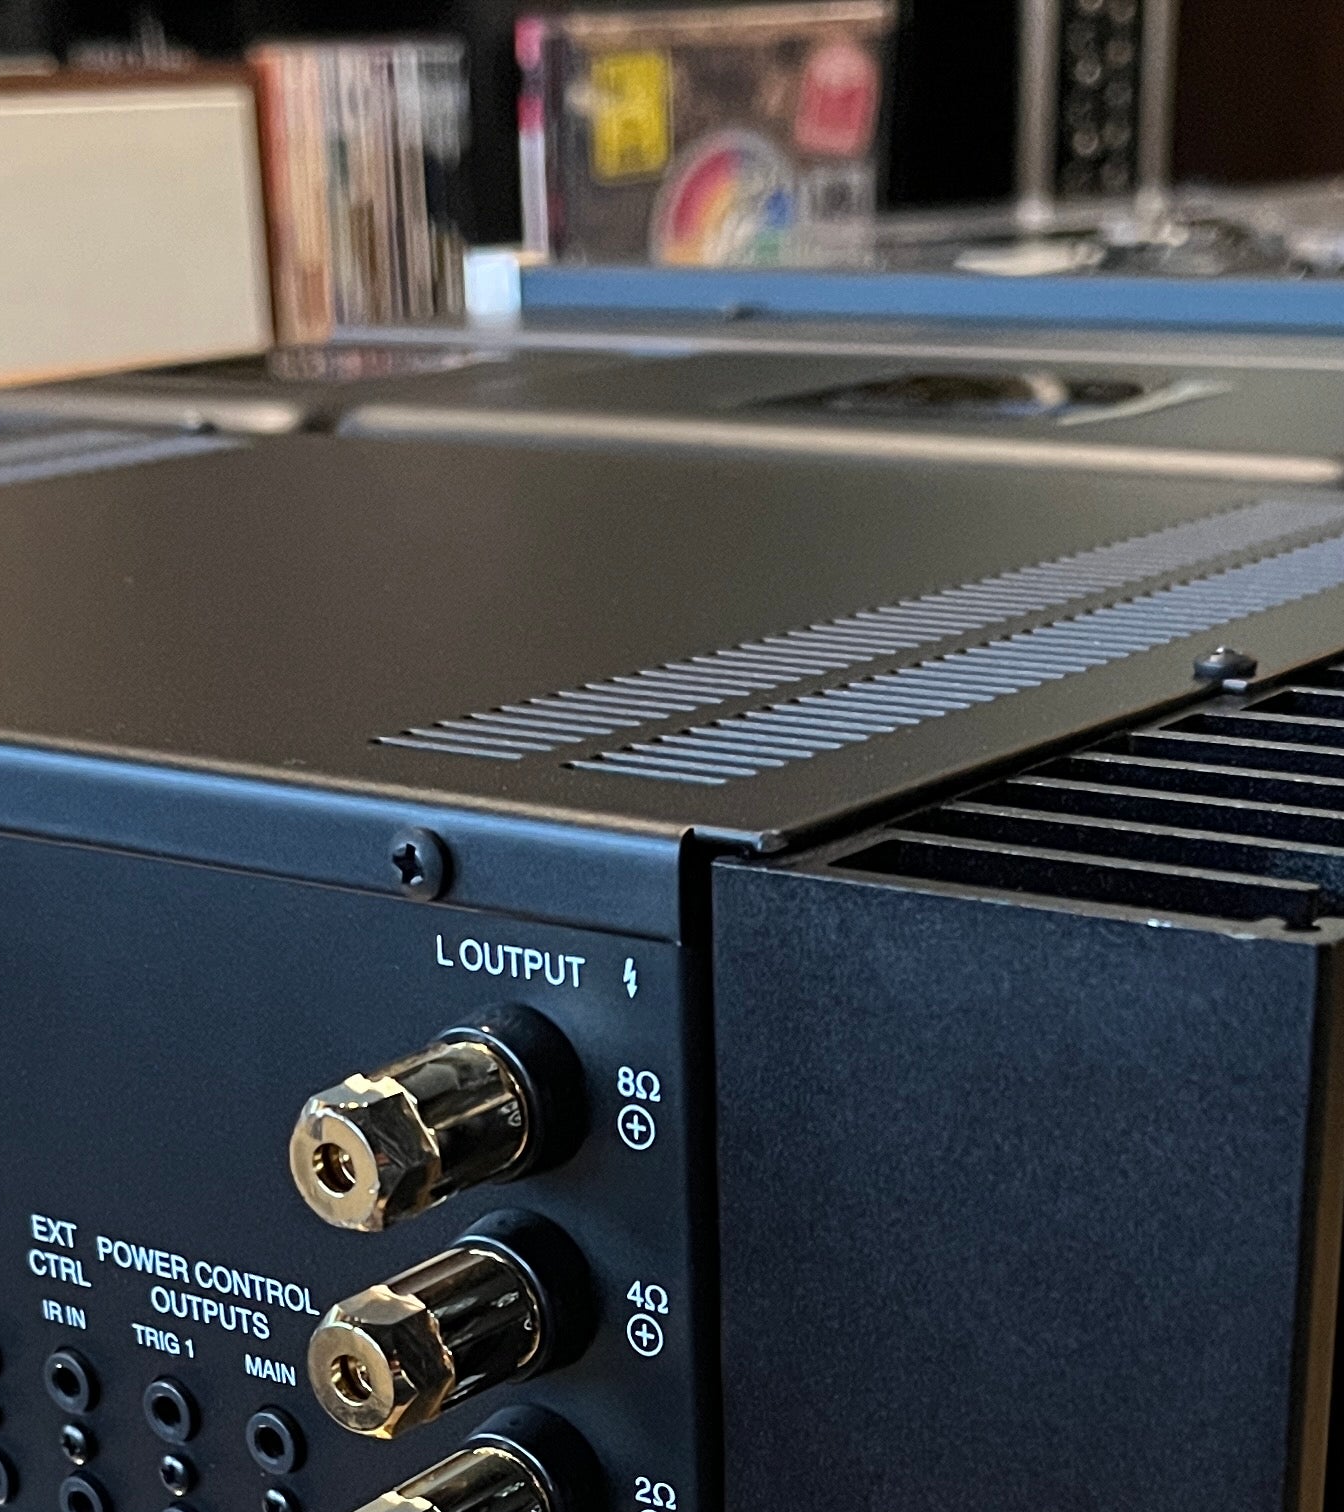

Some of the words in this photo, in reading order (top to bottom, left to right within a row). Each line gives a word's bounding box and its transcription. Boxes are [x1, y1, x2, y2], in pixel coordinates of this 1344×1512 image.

[436, 935, 453, 967] L
[459, 939, 586, 988] OUTPUT
[31, 1214, 77, 1249] EXT
[29, 1249, 92, 1288] CTRL
[96, 1235, 189, 1284] POWER
[194, 1260, 321, 1316] CONTROL
[43, 1299, 64, 1325] IR
[65, 1306, 87, 1330] IN
[151, 1286, 271, 1340] OUTPUTS
[131, 1322, 181, 1355] TRIG
[184, 1338, 195, 1359] 1
[244, 1353, 296, 1387] MAIN
